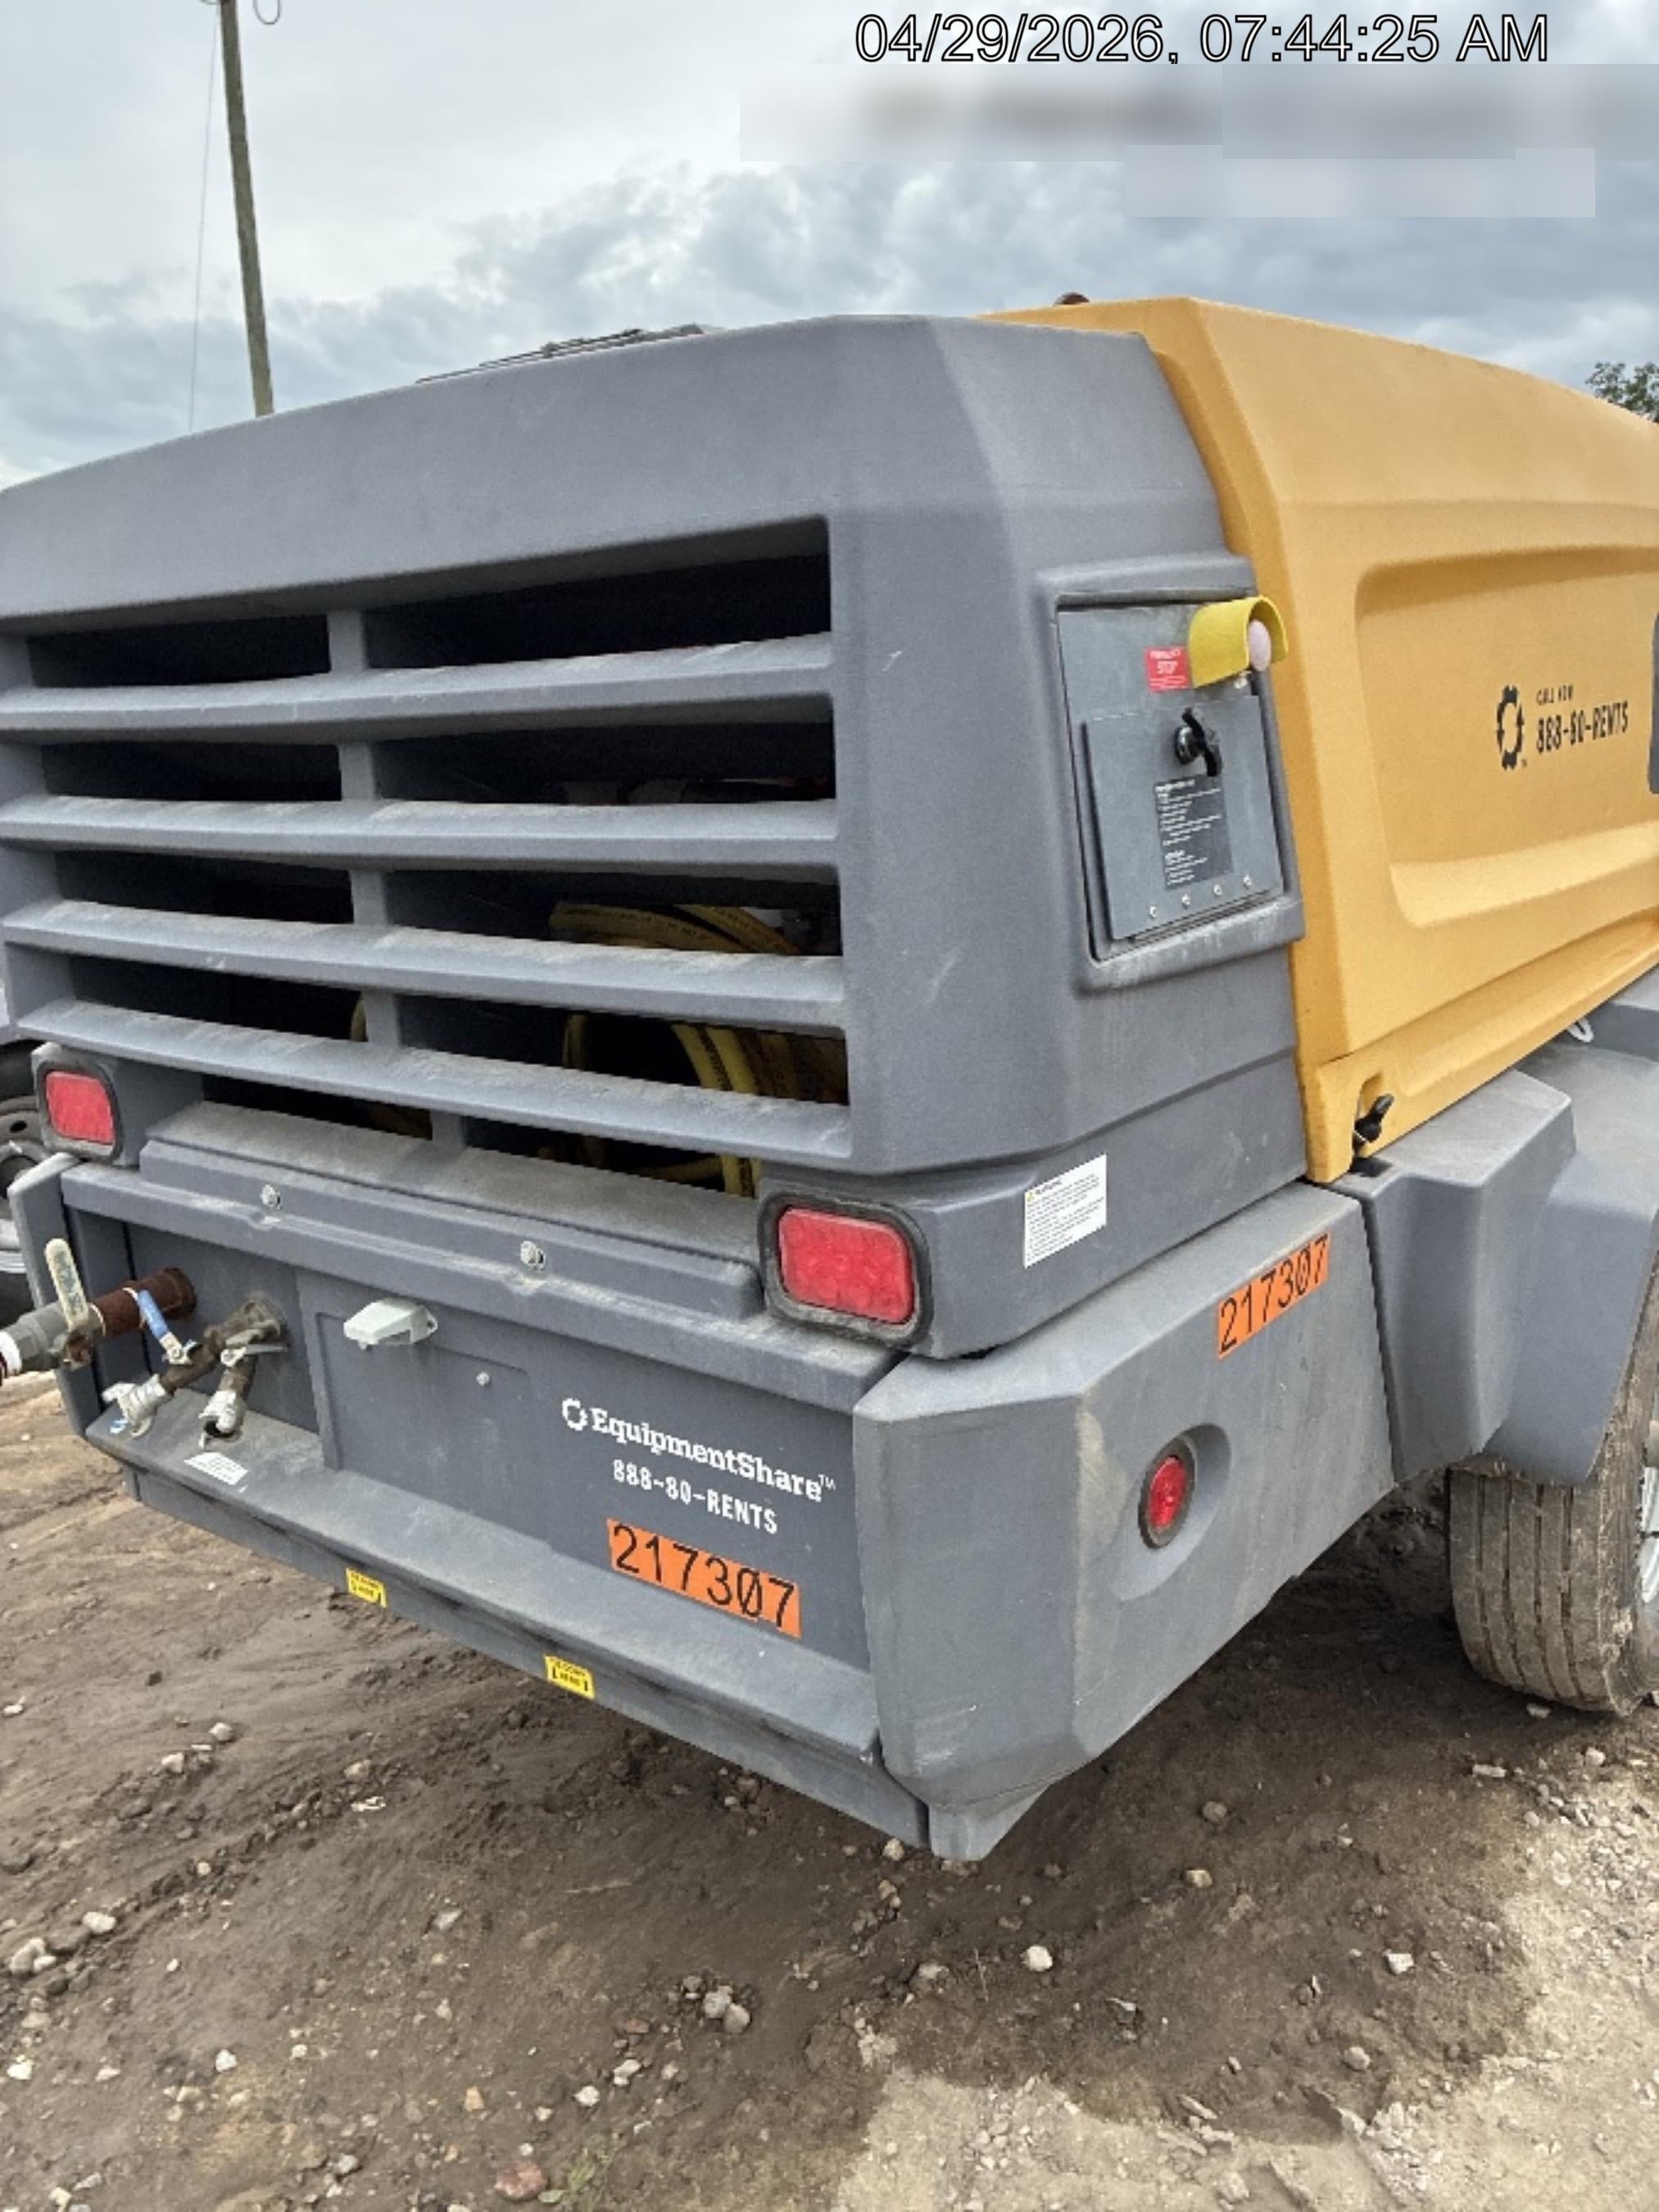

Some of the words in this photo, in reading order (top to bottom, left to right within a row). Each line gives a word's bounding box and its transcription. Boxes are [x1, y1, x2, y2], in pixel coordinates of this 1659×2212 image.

[1220, 1233, 1329, 1353] 217307
[613, 1459, 777, 1534] 888-80-RENTS
[613, 1523, 795, 1628] 217307
